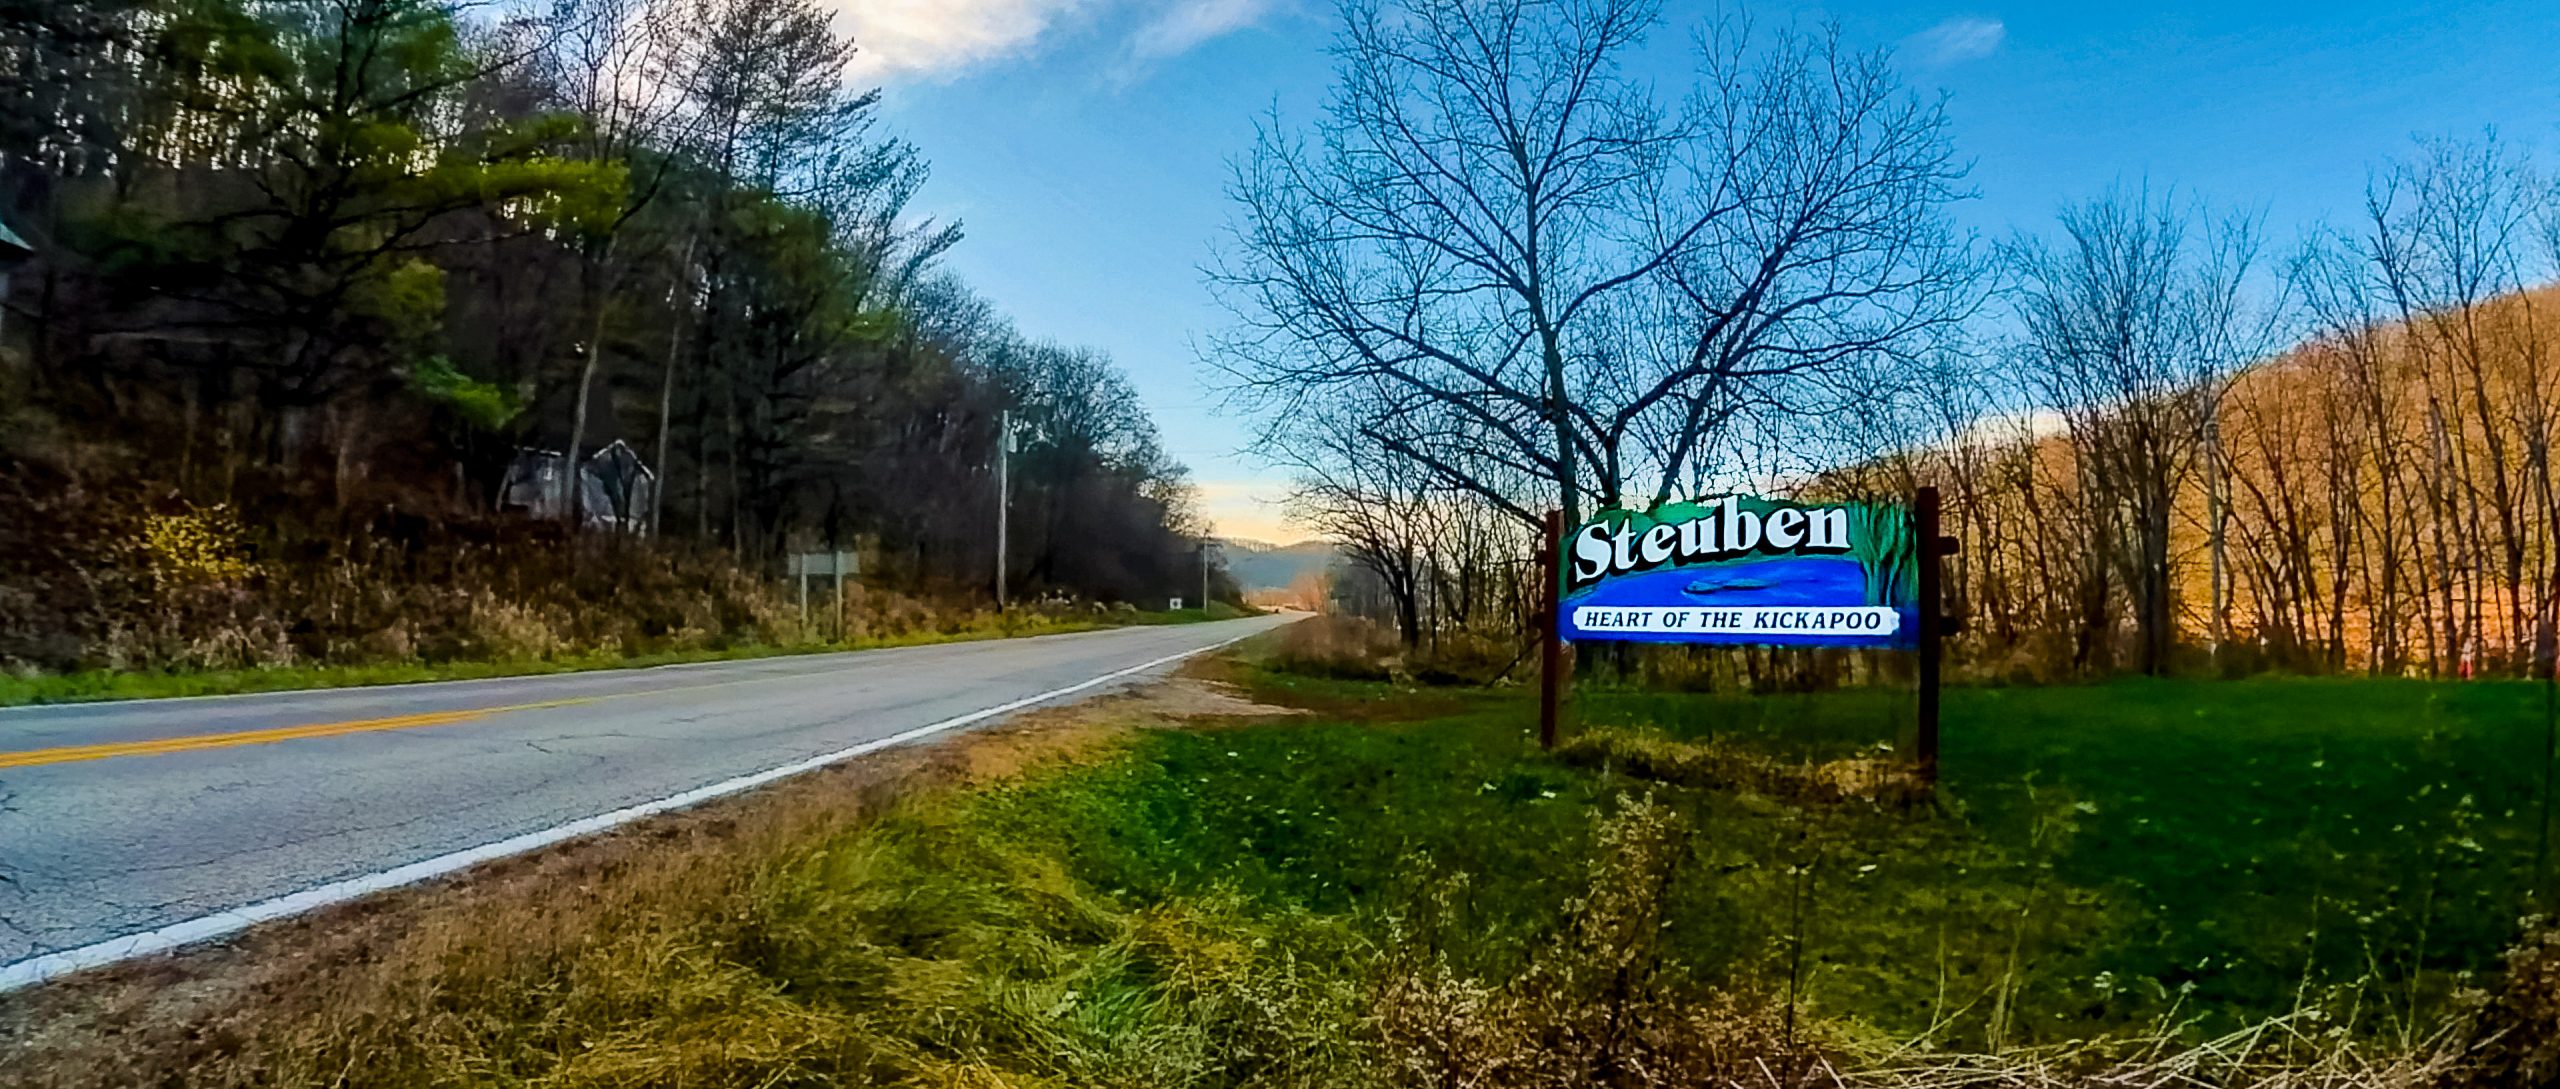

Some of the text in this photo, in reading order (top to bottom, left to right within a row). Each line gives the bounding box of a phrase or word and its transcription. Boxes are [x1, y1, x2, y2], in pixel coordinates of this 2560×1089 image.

[1574, 496, 1851, 583] Steuben
[1584, 612, 1881, 629] HEART OF THE KICKAPOO
